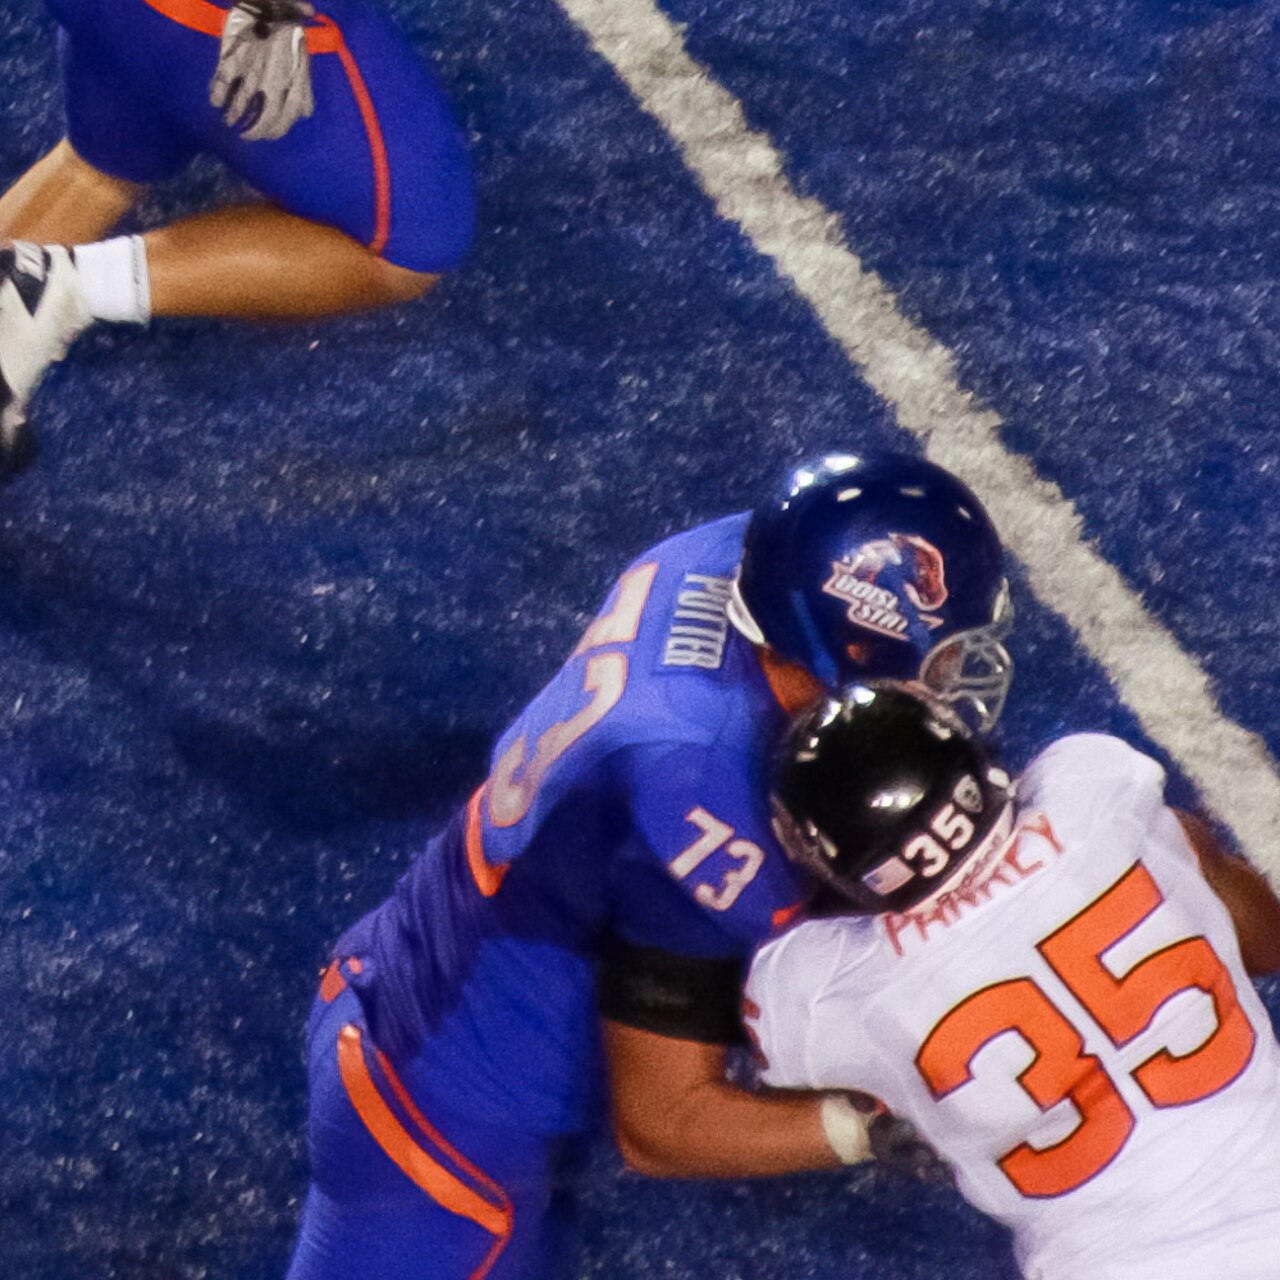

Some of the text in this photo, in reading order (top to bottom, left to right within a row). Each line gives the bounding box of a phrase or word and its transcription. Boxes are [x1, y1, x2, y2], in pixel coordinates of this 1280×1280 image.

[662, 573, 730, 670] POTTER
[667, 806, 765, 911] 73
[903, 802, 976, 879] 35
[915, 859, 1257, 1199] 35
